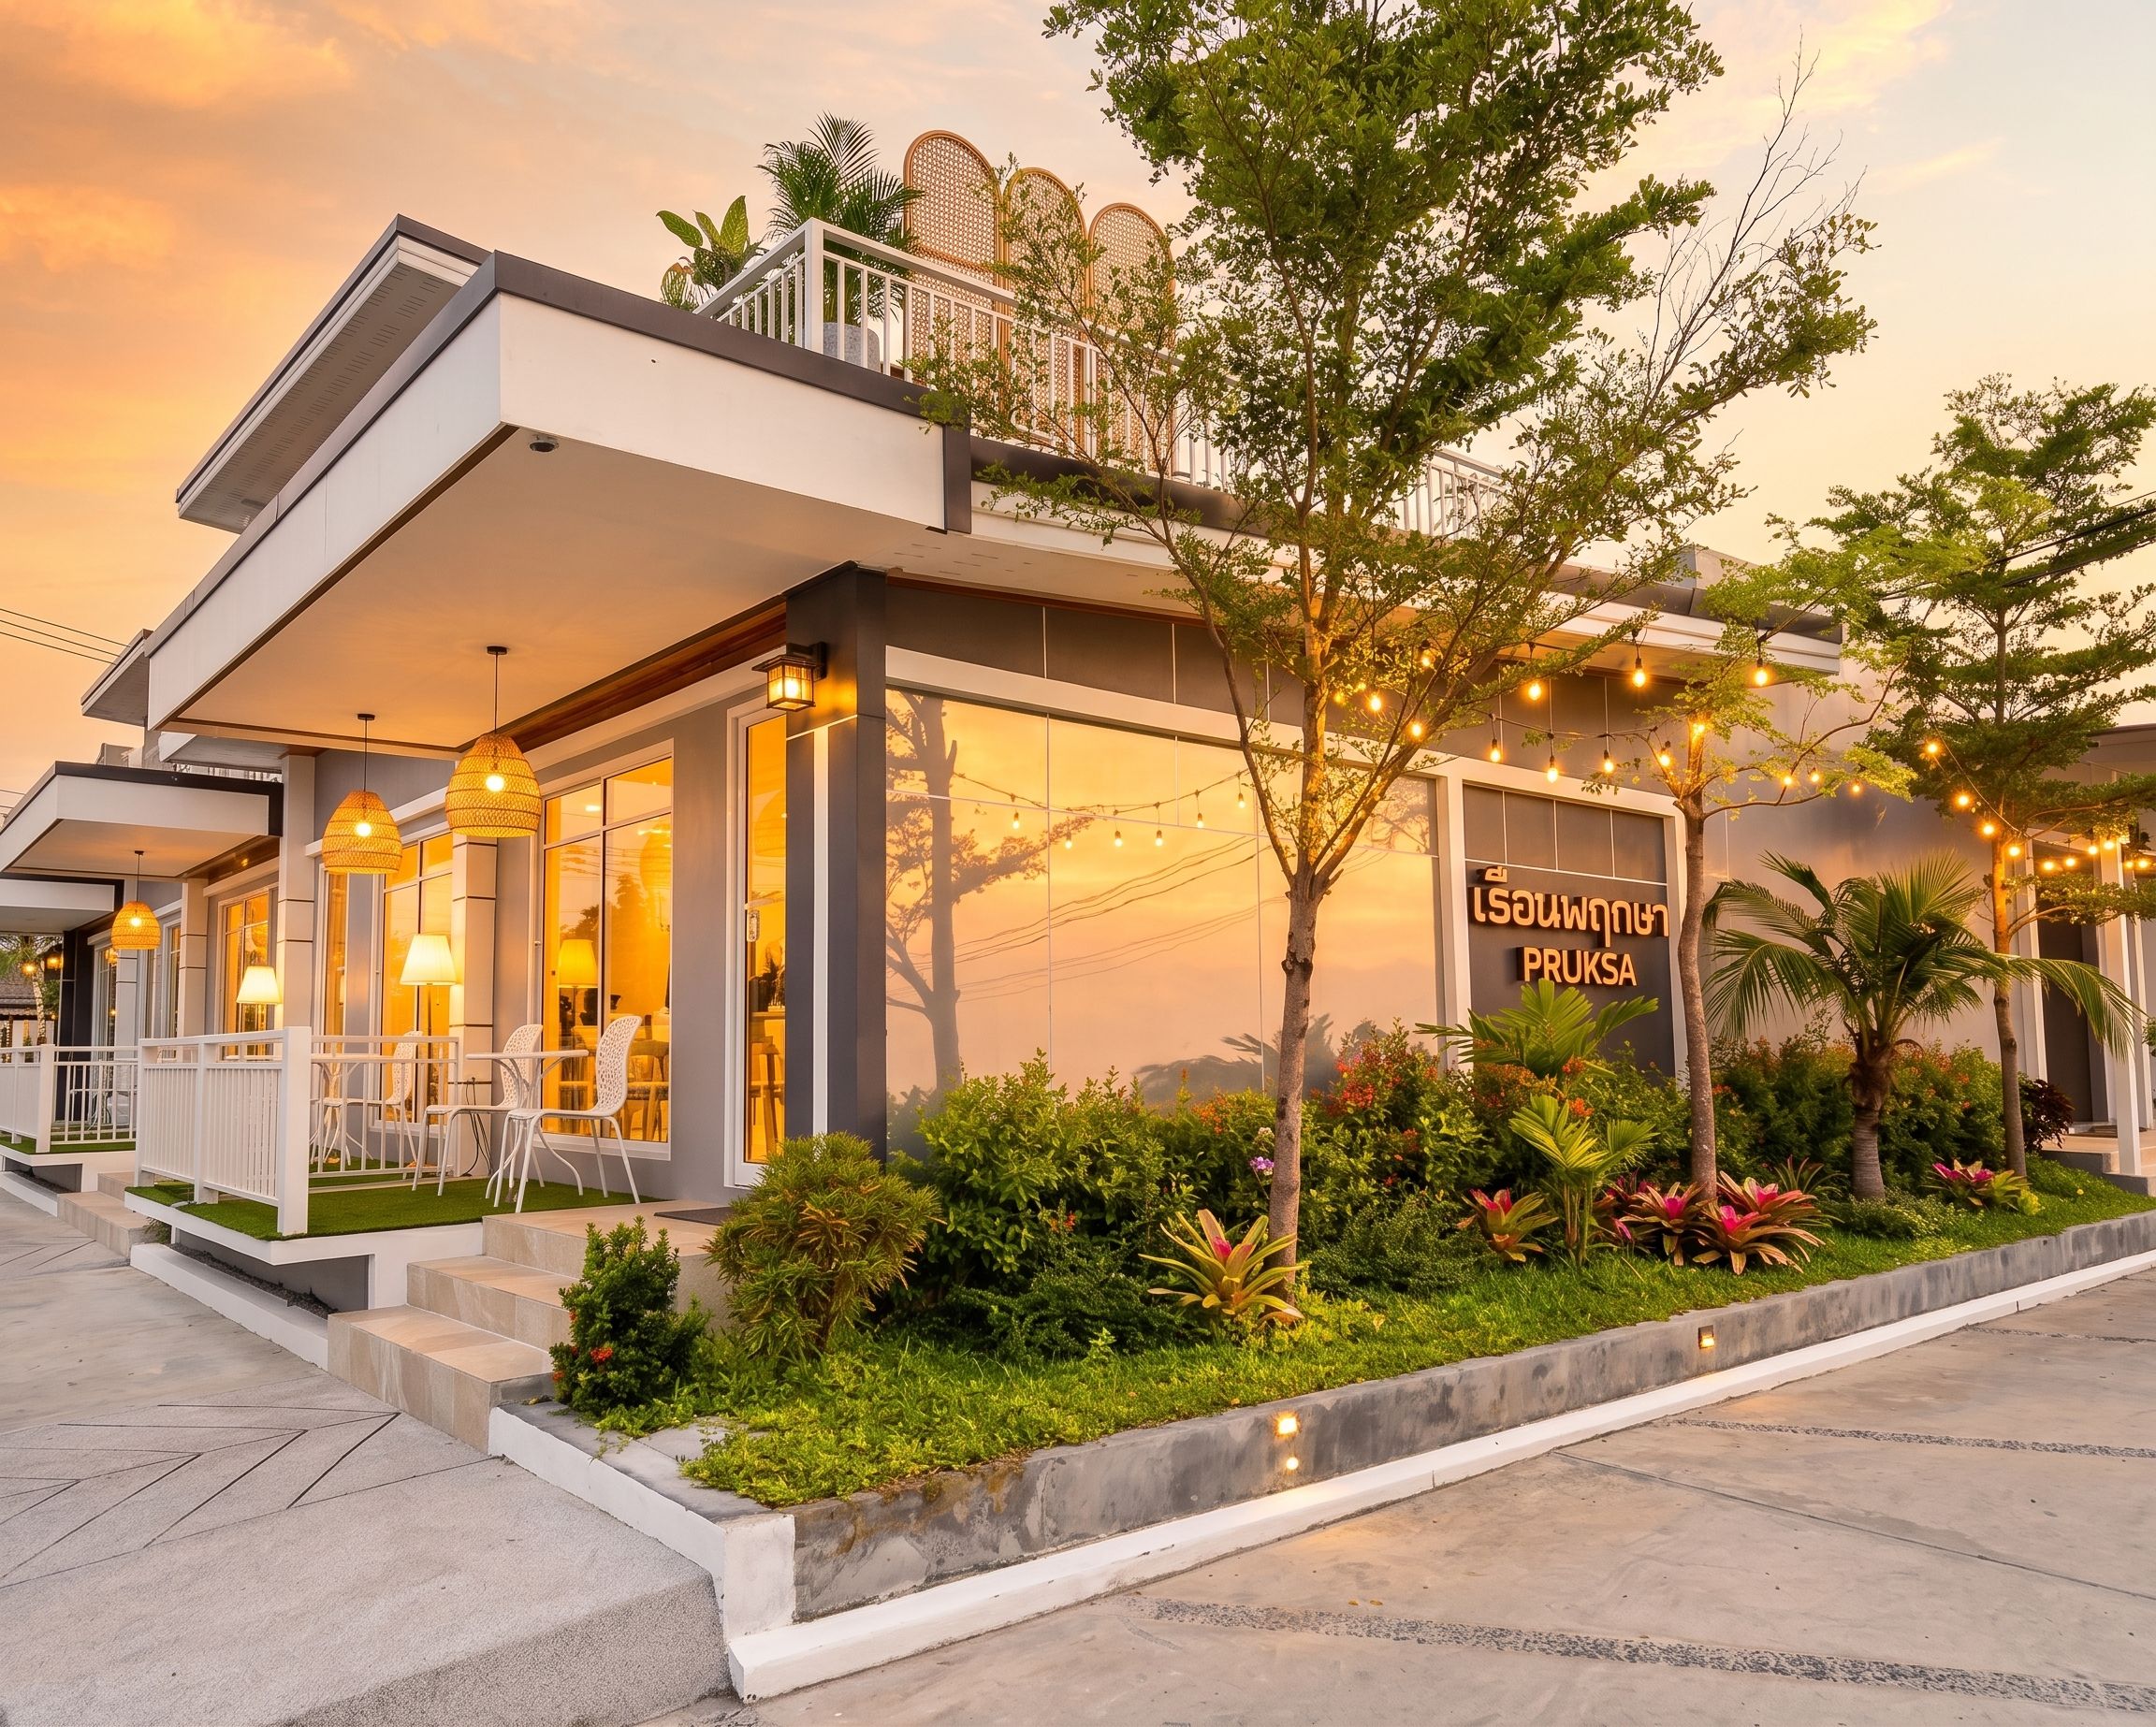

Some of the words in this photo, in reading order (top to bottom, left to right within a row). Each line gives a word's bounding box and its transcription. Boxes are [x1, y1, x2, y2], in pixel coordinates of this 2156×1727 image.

[1473, 865, 1669, 948] เรือนพฤกษา
[1522, 946, 1638, 987] PRUKSA
